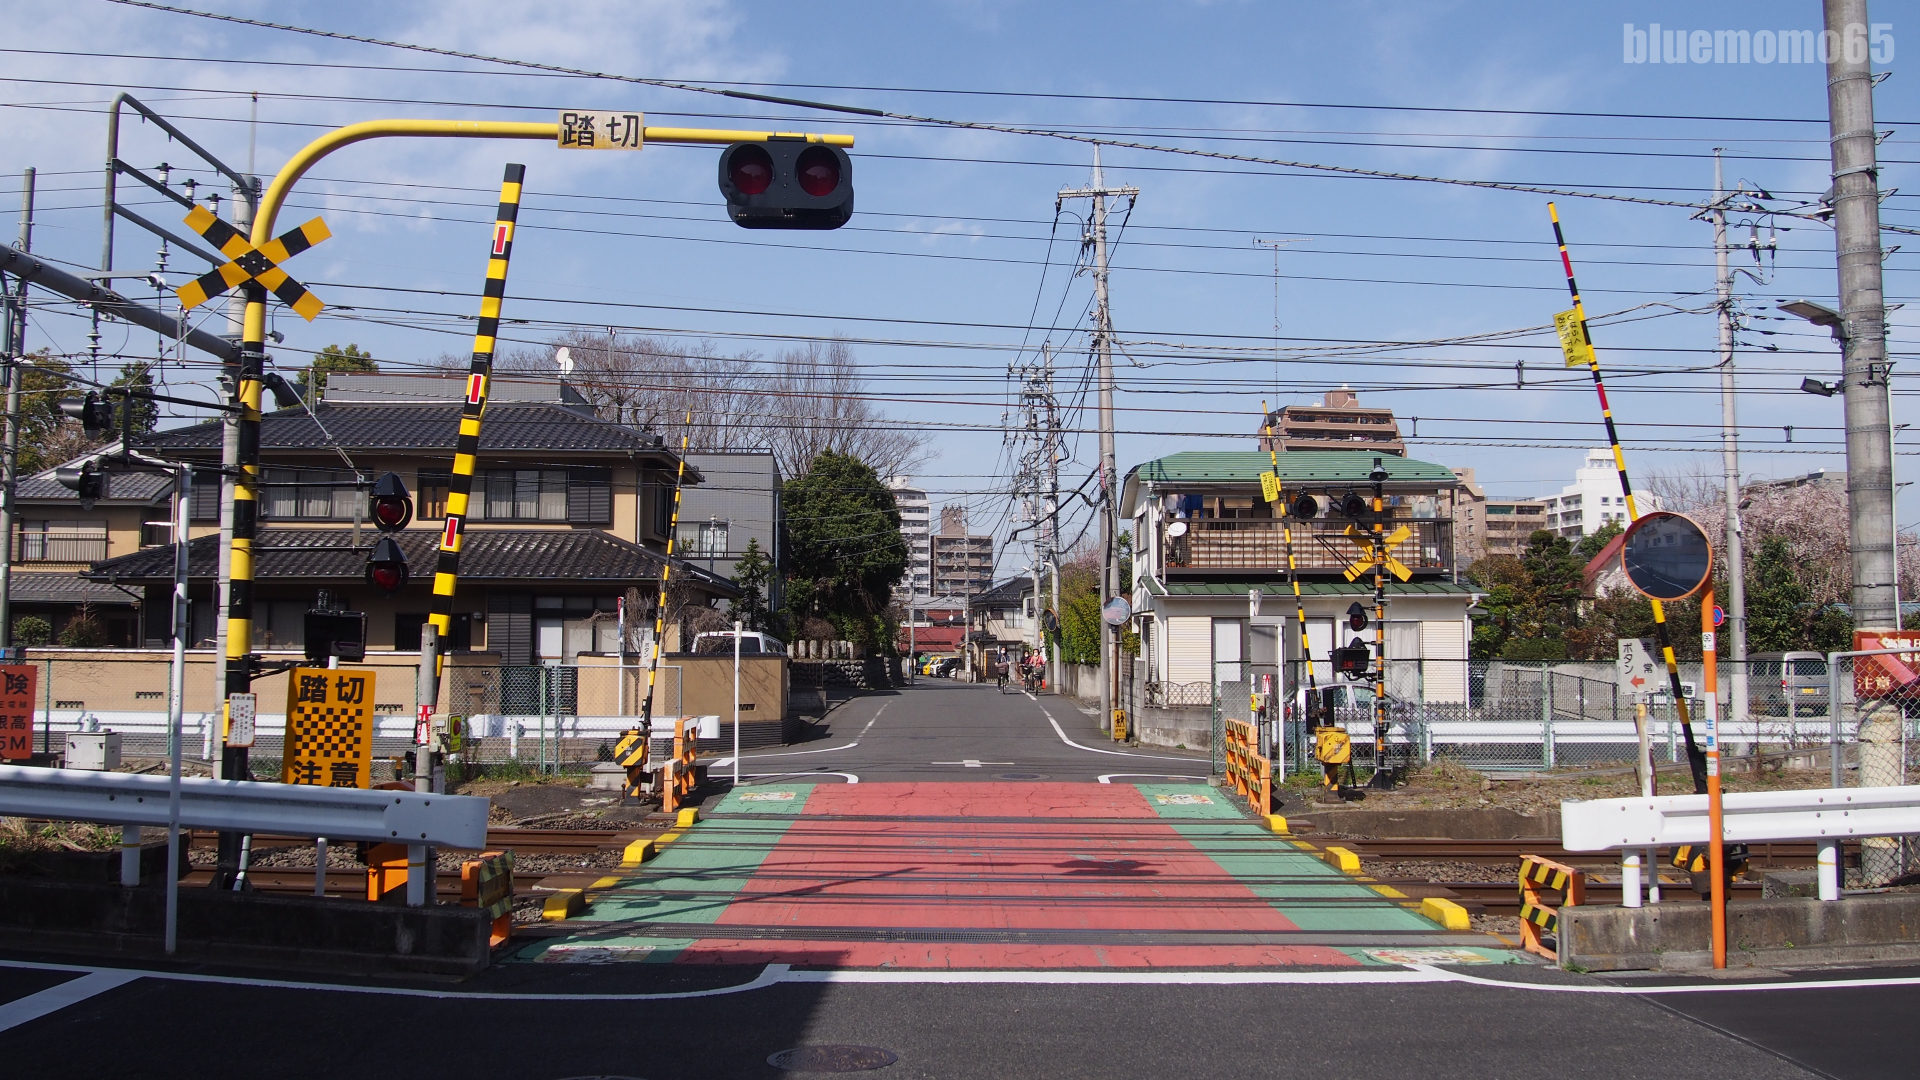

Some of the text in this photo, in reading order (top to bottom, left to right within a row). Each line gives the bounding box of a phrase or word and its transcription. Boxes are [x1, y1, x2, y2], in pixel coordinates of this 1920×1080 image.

[562, 113, 639, 147] 踏切
[1623, 642, 1634, 675] ボタン
[298, 674, 365, 704] 踏切
[292, 760, 359, 788] 注意
